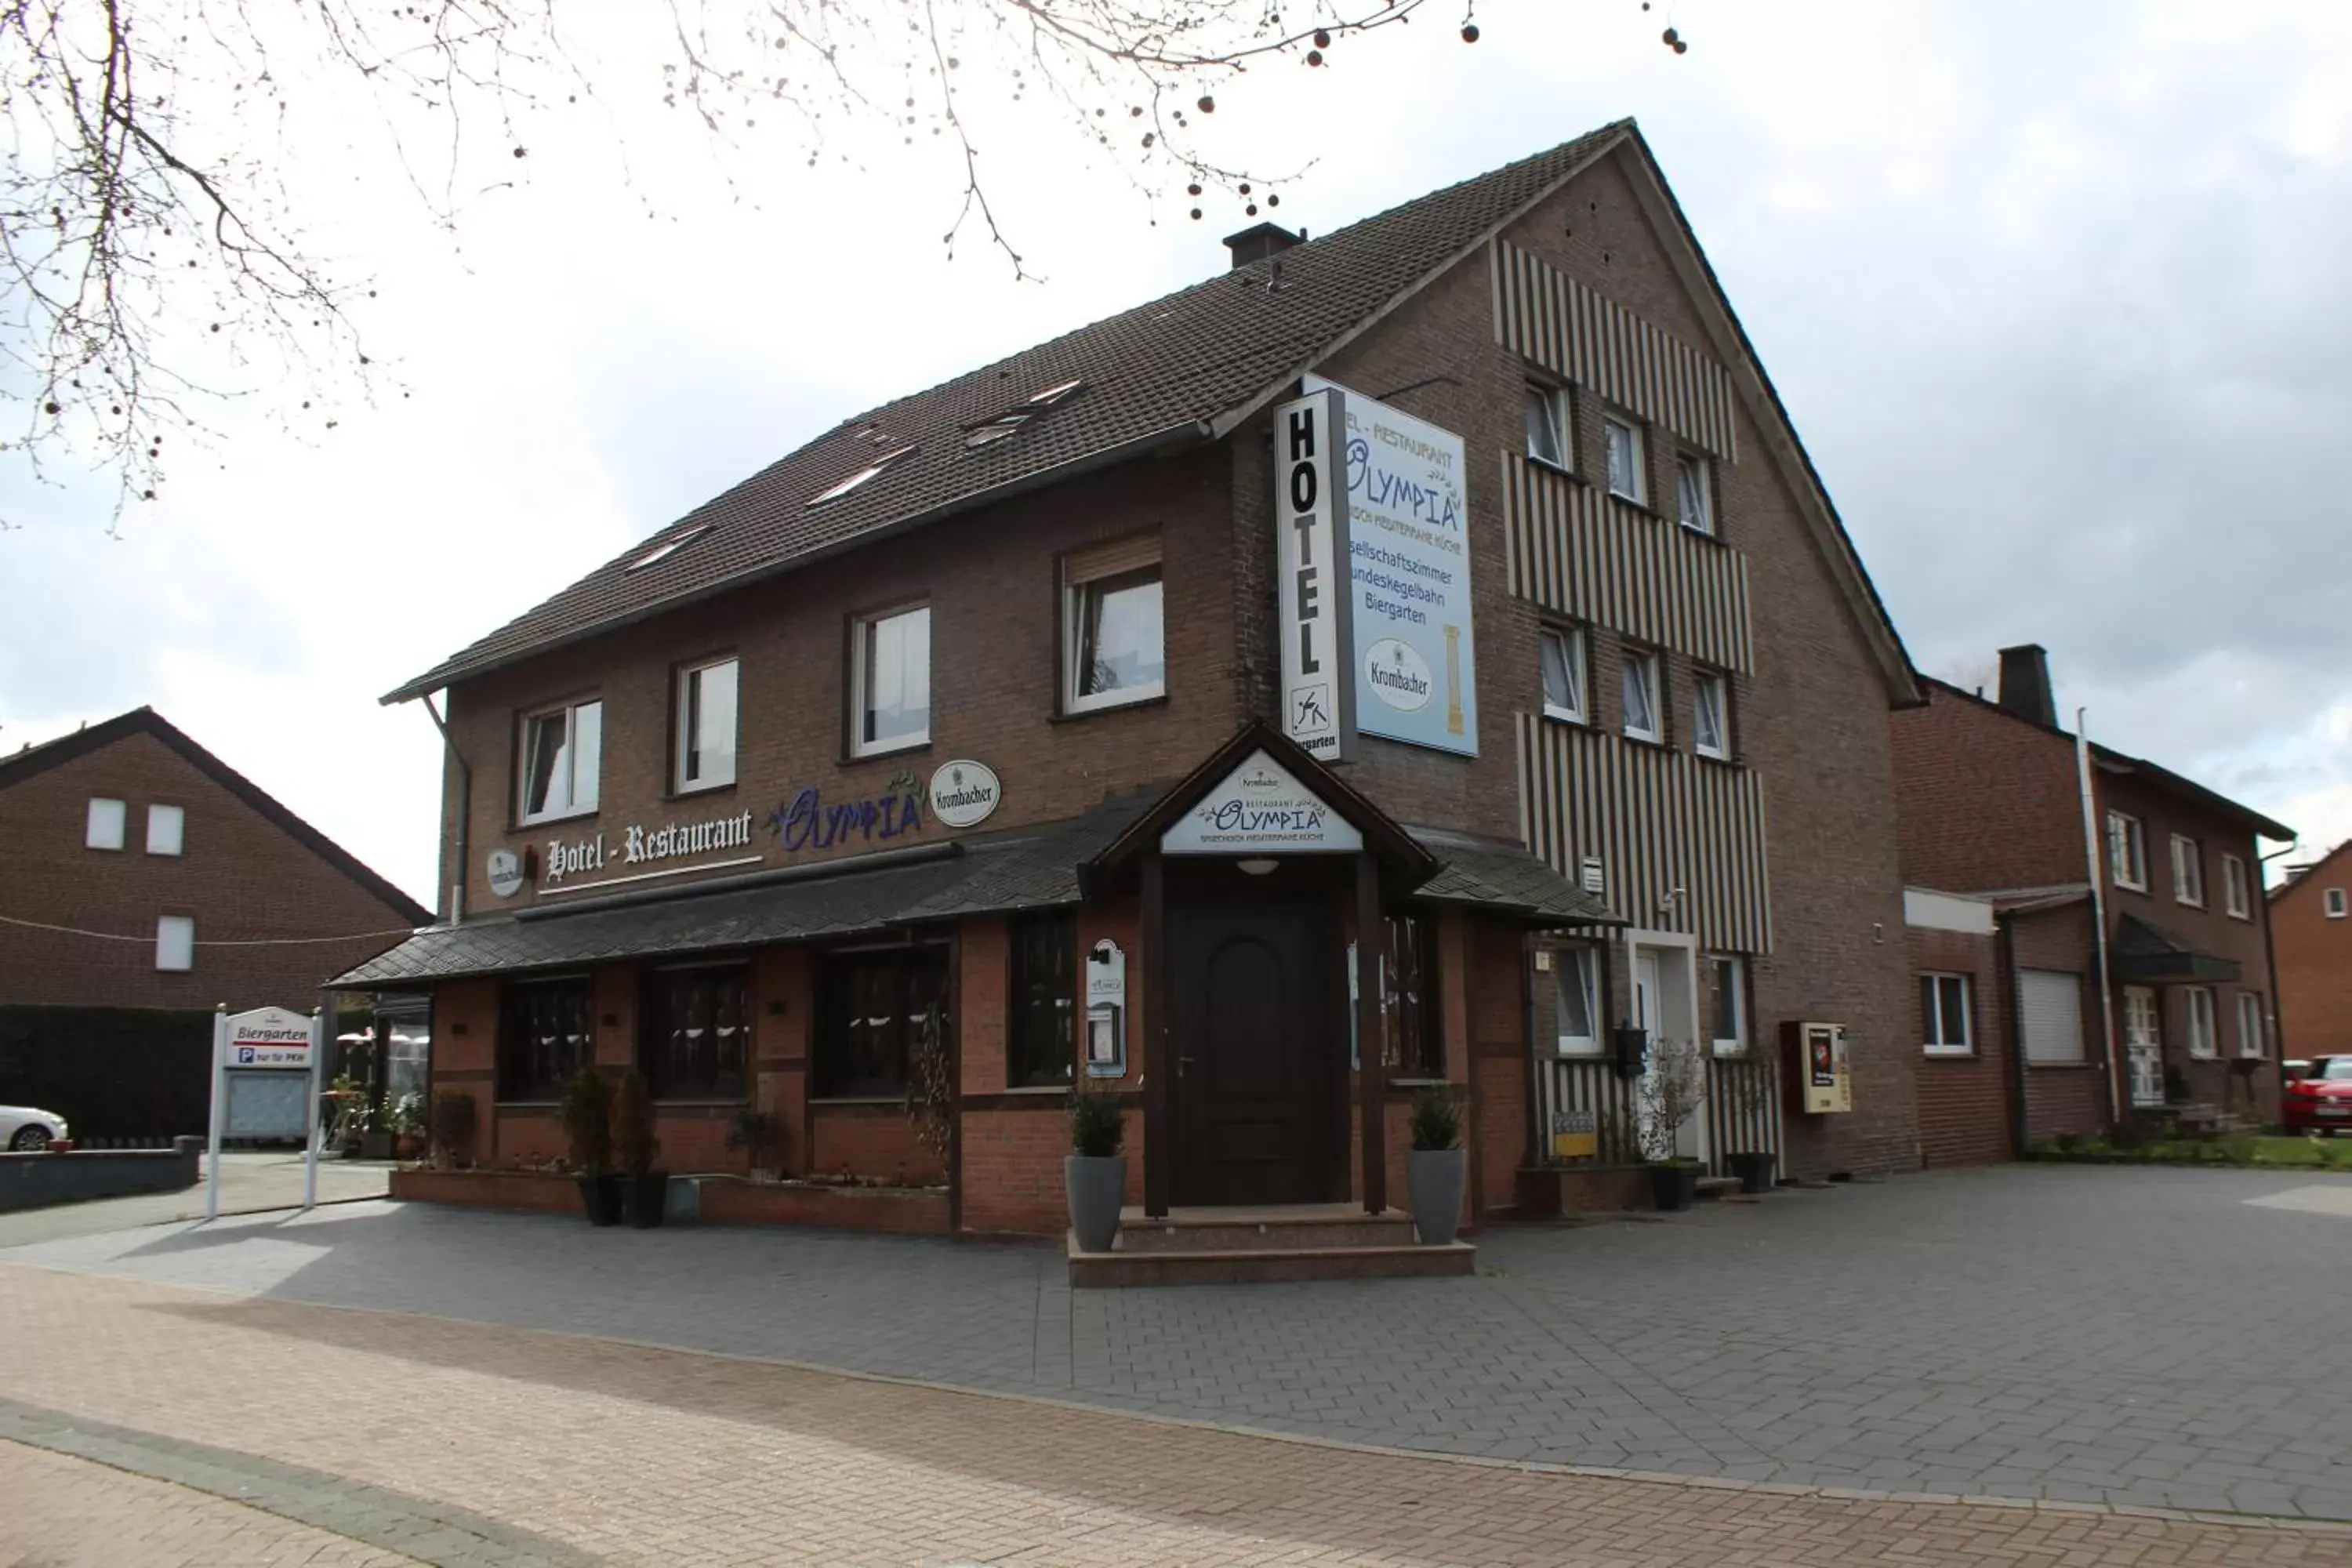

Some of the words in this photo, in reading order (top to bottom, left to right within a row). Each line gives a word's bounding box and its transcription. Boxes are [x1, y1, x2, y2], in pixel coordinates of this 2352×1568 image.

[1374, 423, 1453, 469] RESTAURANT
[1345, 438, 1458, 532] OLYMPIA
[1290, 408, 1320, 676] HOTEL
[1349, 540, 1453, 585] sellschaftszimmer
[1351, 568, 1446, 608] undeskegelbahn
[1366, 592, 1427, 625] Biergarten
[1371, 661, 1428, 696] Krombacher
[935, 784, 992, 811] Krombacher
[1215, 799, 1321, 830] OLYMPIA
[546, 832, 604, 883] Hotel
[623, 808, 752, 864] Restaurant
[238, 1026, 307, 1041] Biergarten
